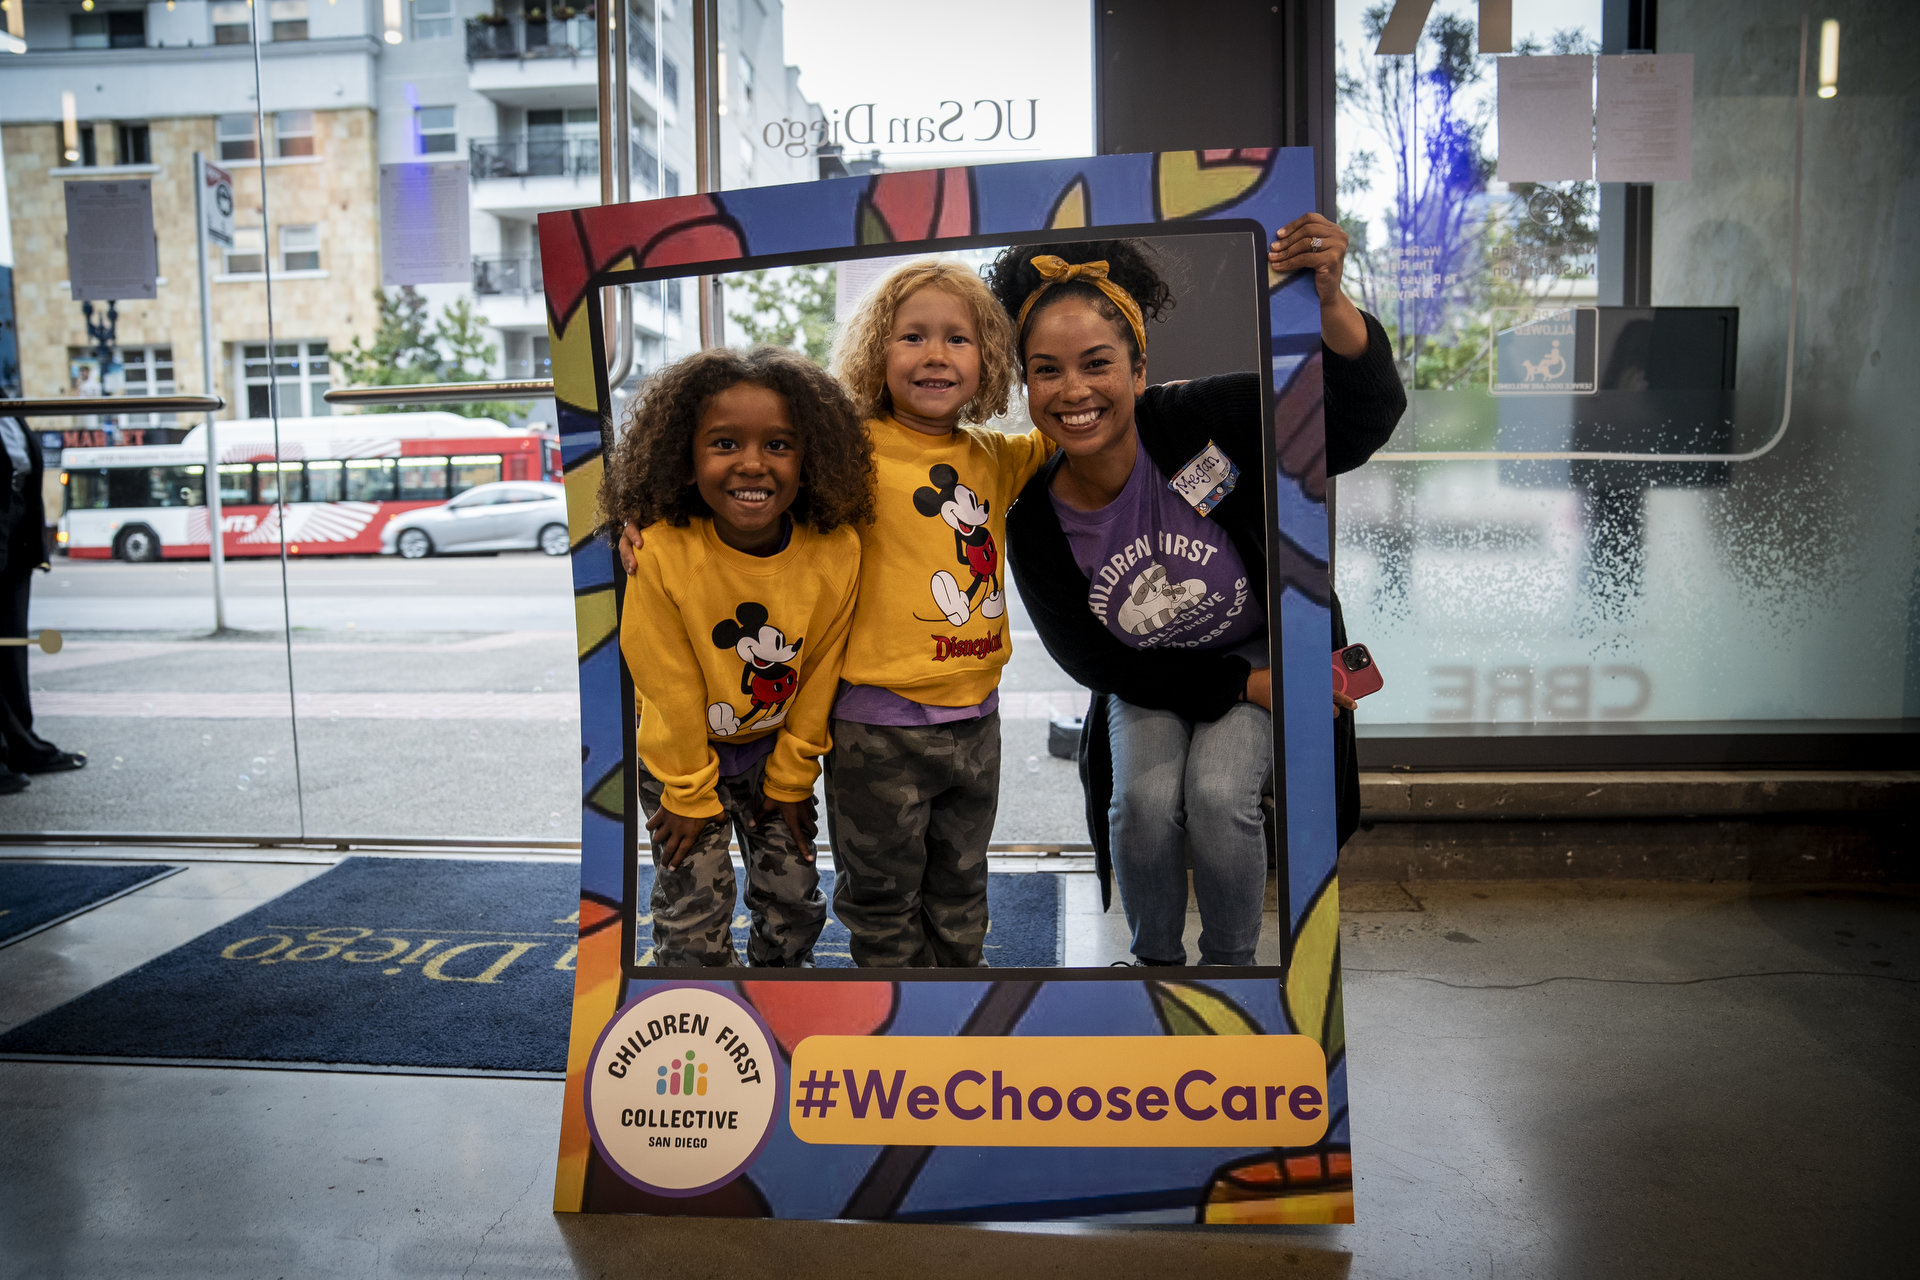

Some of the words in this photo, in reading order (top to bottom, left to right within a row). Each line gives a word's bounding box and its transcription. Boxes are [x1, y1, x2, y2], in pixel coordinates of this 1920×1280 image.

[63, 430, 145, 447] MARET
[1175, 456, 1220, 494] Megan
[1159, 530, 1218, 566] FIRST
[1226, 576, 1248, 617] Care
[1138, 592, 1226, 648] COLLECTIVE
[1184, 613, 1214, 630] DIEGO
[220, 926, 547, 984] Diego
[608, 1013, 710, 1079] CHILDREN
[715, 1026, 761, 1084] FIRST
[795, 1069, 1323, 1122] #WeChooseCare
[621, 1108, 739, 1130] COLLECTIVE
[648, 1136, 671, 1147] SAN
[674, 1137, 708, 1149] DIEGO
